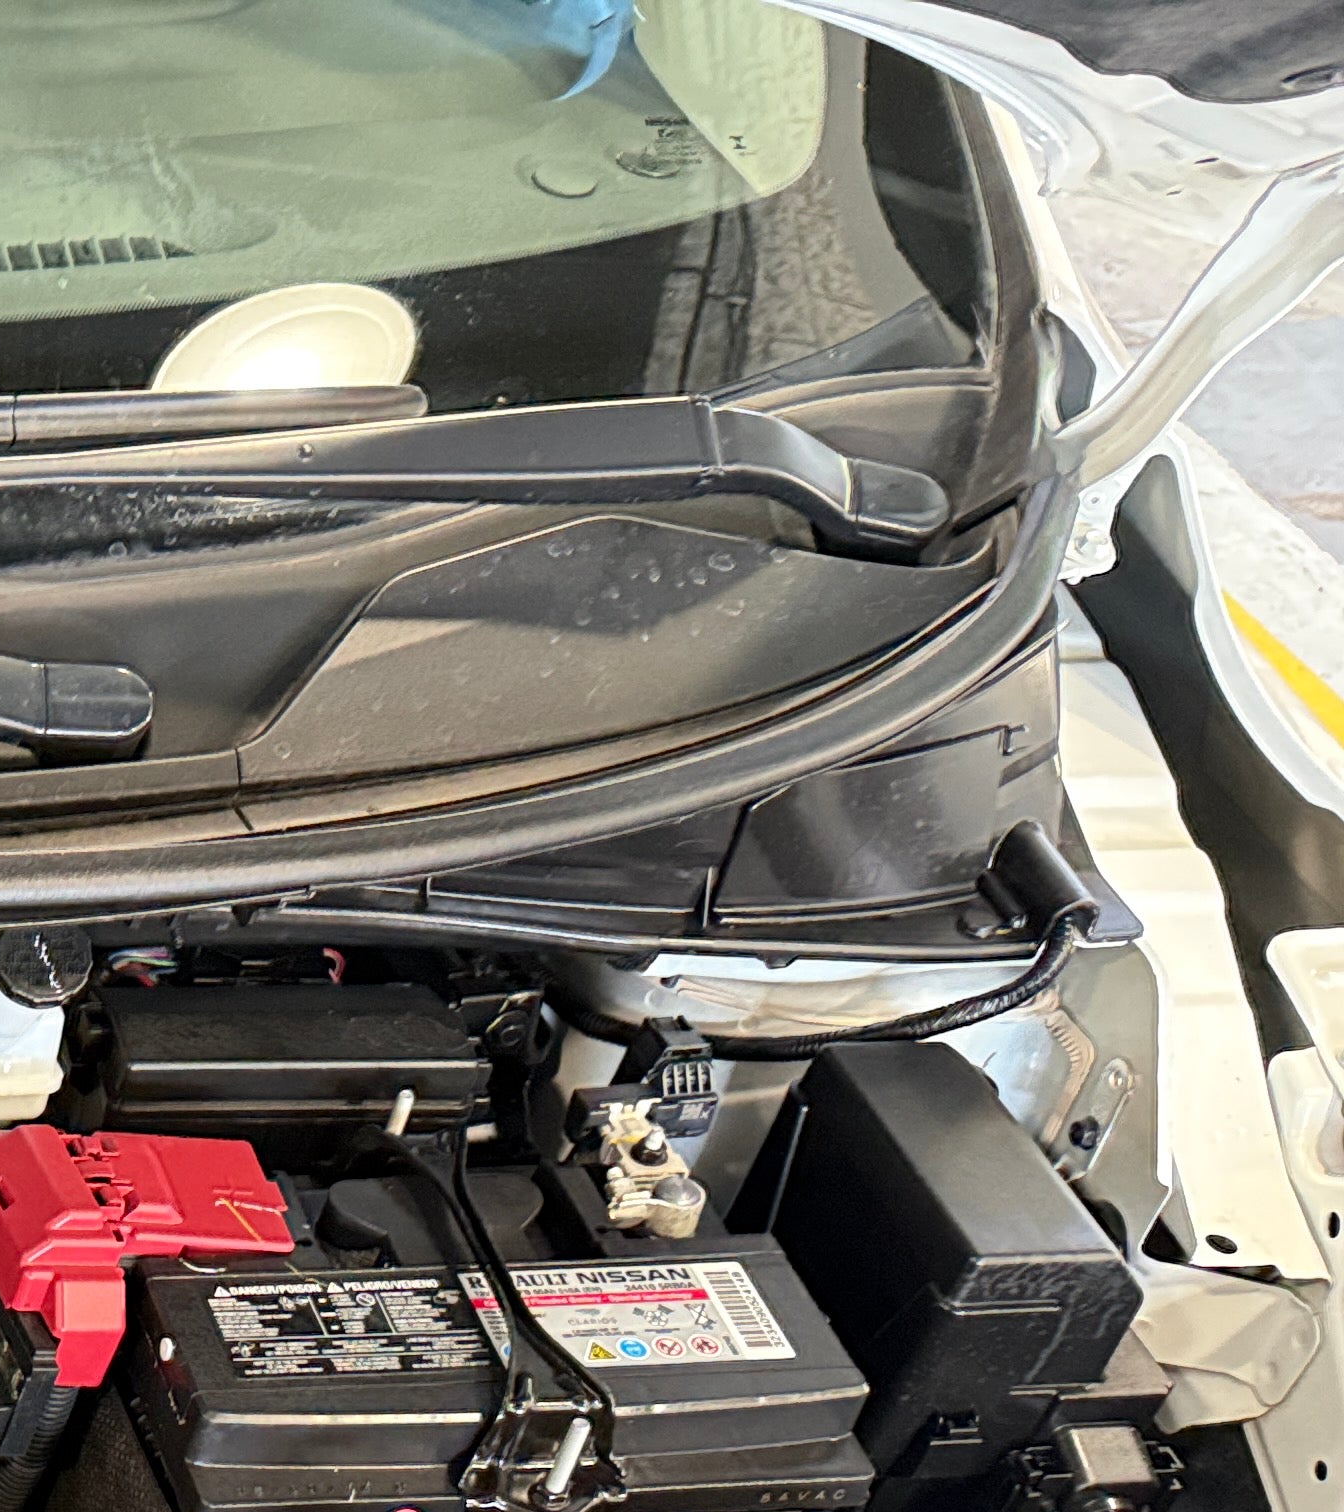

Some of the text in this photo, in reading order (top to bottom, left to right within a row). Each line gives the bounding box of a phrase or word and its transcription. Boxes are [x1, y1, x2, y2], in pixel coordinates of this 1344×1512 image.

[229, 1279, 439, 1296] DANGER/POISON PELIGRO/VENENO
[466, 1267, 691, 1289] RAULT NISSAN
